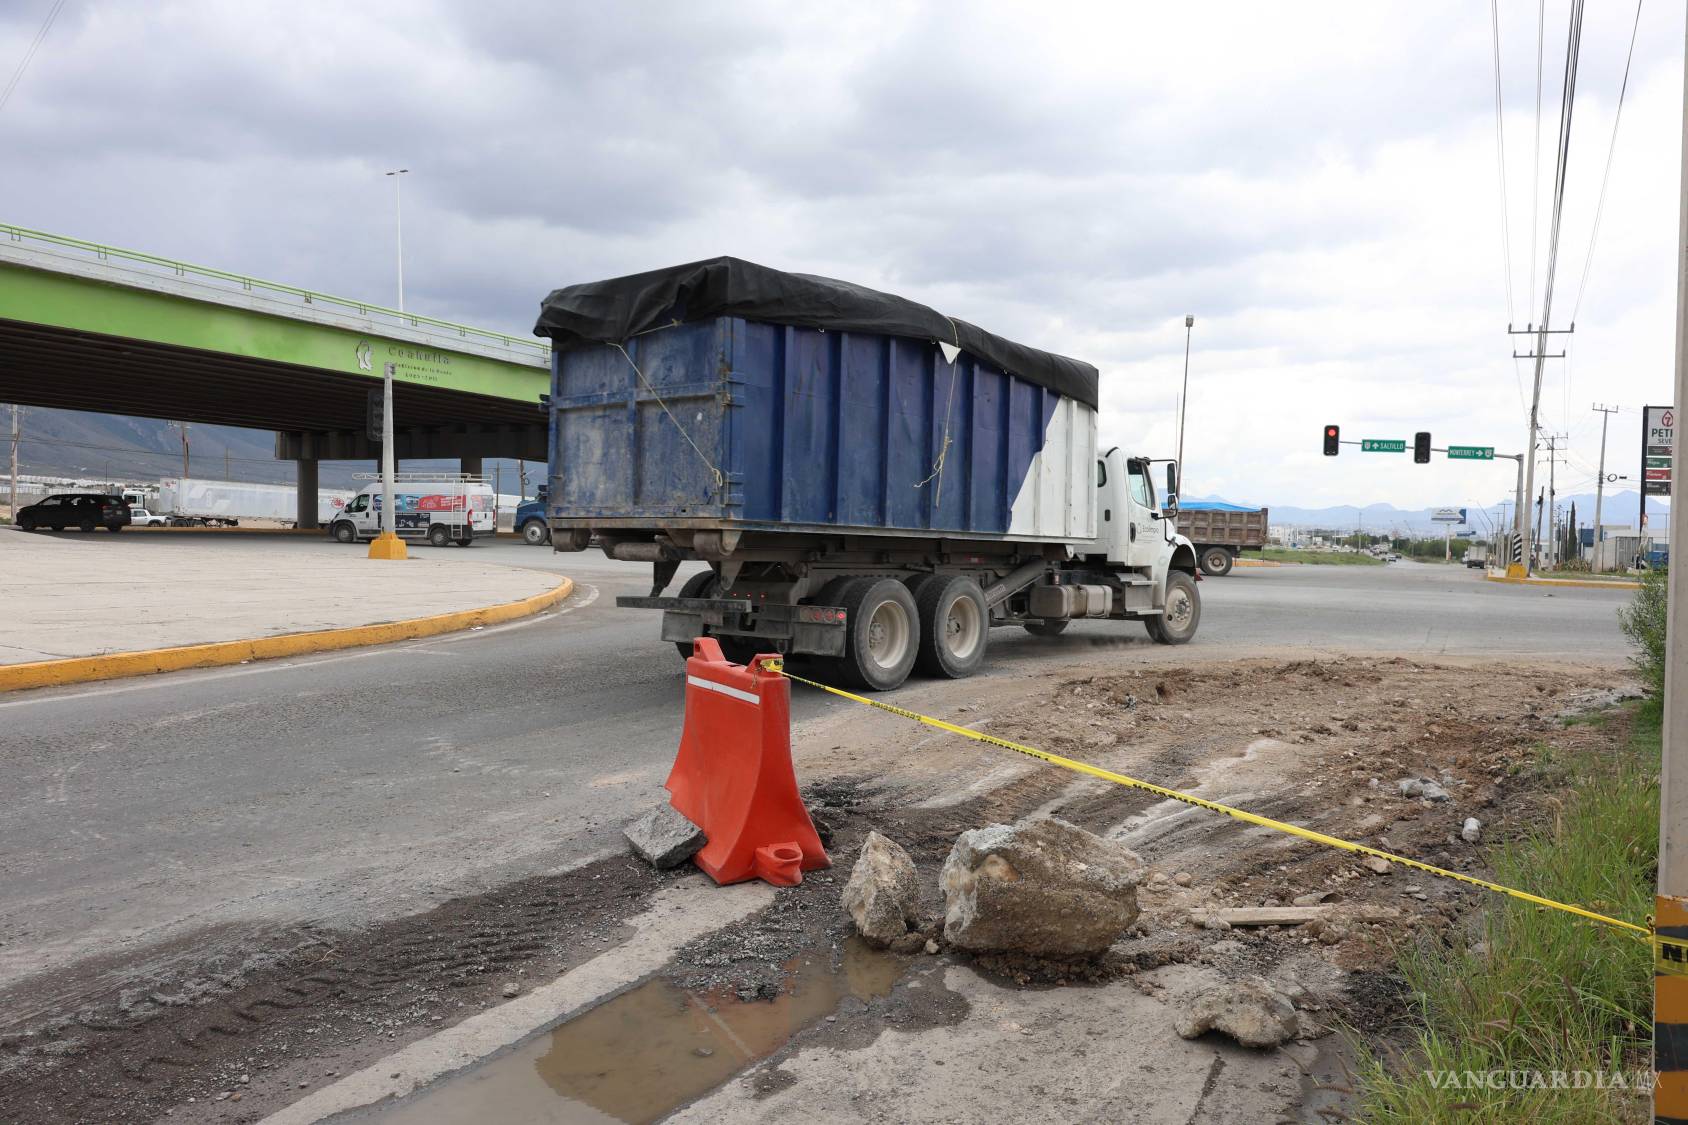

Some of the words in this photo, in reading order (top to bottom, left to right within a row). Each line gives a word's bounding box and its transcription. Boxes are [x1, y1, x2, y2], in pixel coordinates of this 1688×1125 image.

[1651, 428, 1673, 438] PET
[1380, 442, 1404, 450] SALTILLO
[1449, 449, 1475, 457] MONTERREY
[1662, 943, 1688, 963] N
